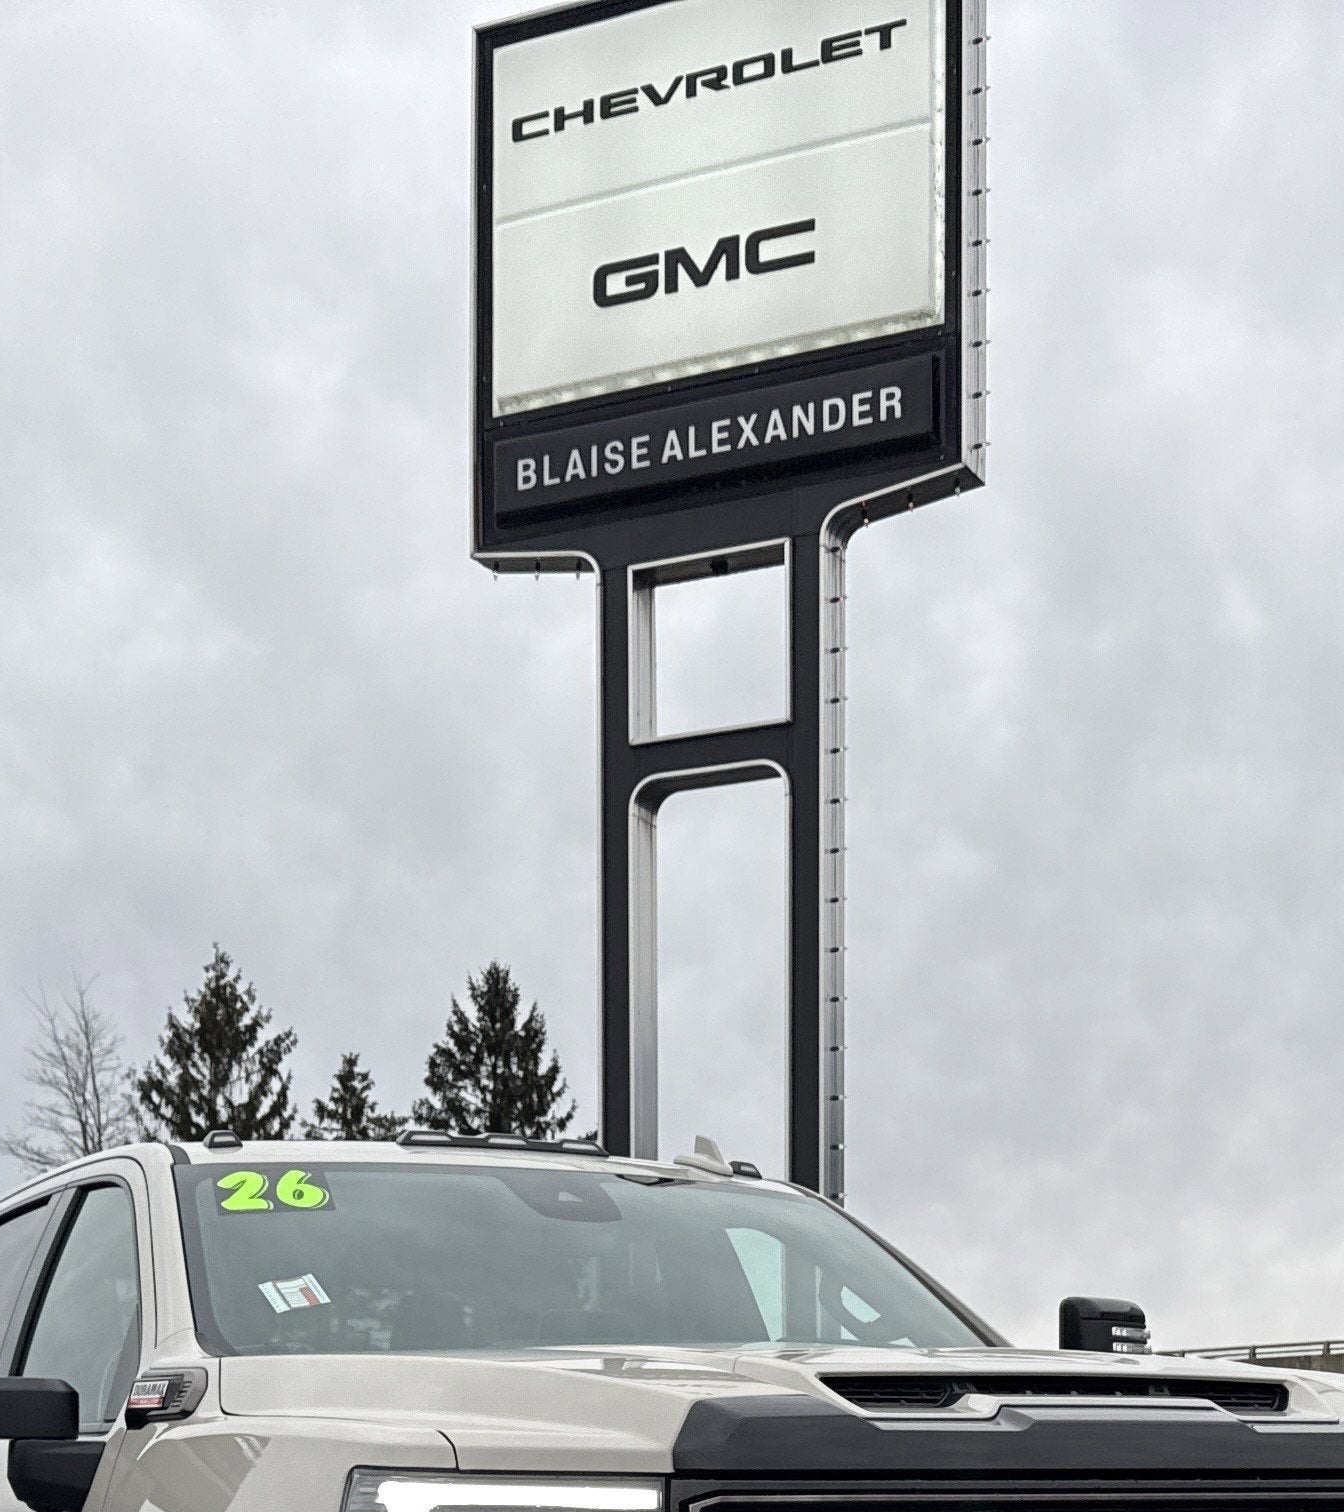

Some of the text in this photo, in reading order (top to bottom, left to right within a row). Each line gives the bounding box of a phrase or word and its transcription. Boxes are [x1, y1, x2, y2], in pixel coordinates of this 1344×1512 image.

[511, 18, 907, 143] CHEVROLET
[593, 218, 816, 308] GMC
[516, 386, 903, 491] BLAISE ALEXANDER
[216, 1169, 330, 1212] 26
